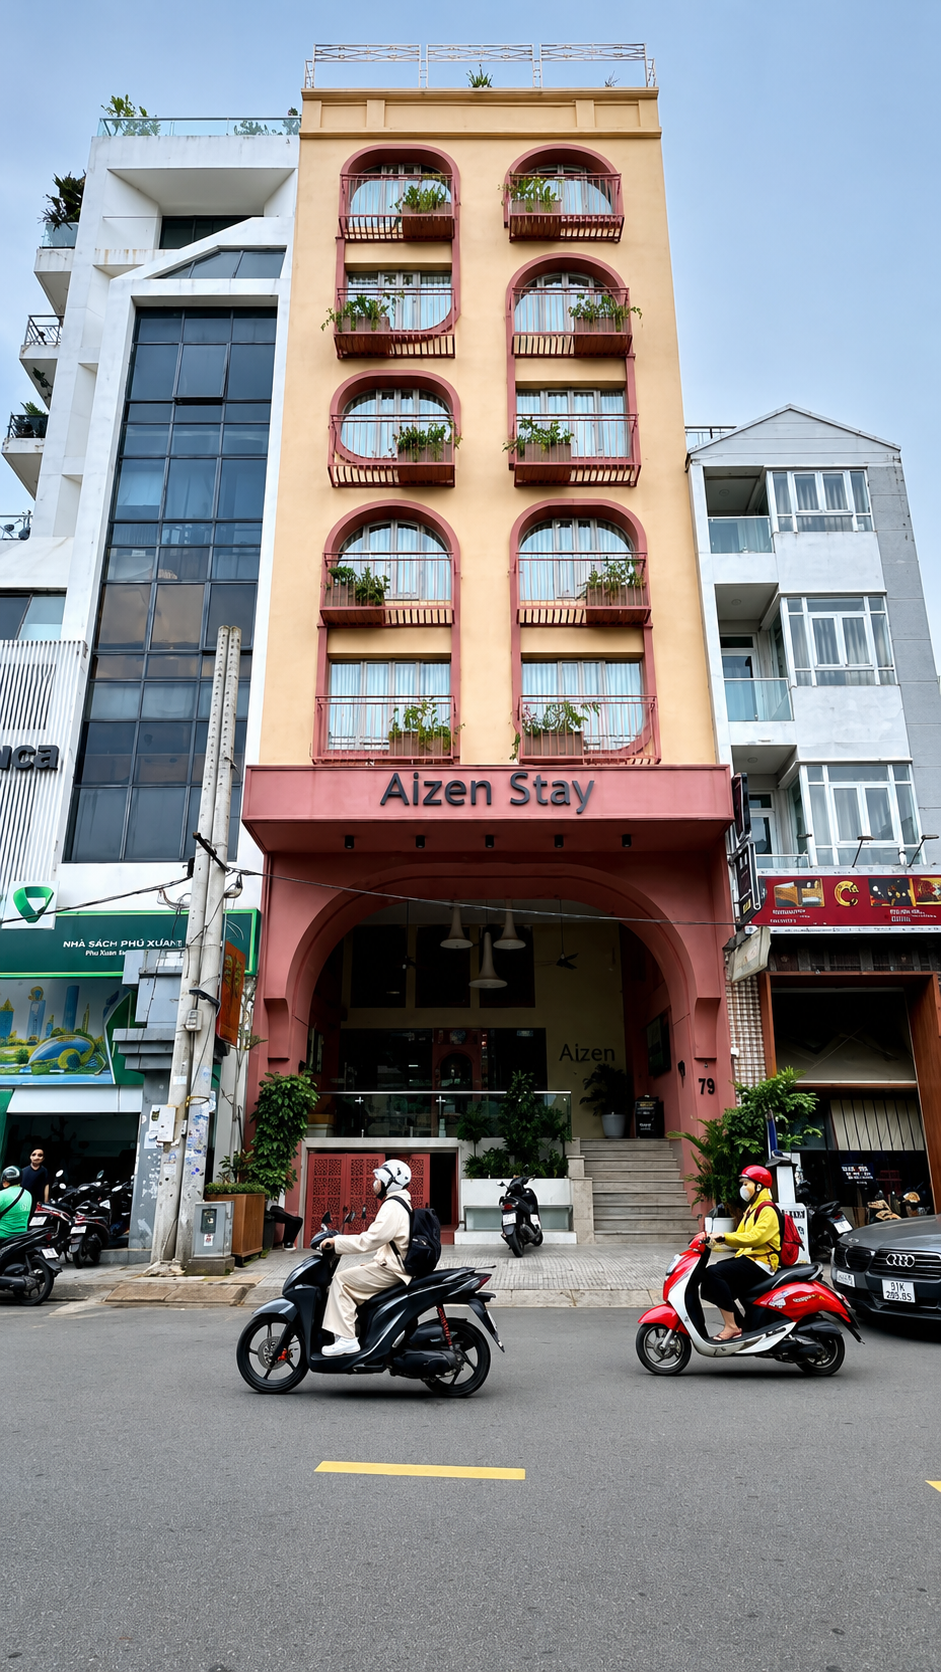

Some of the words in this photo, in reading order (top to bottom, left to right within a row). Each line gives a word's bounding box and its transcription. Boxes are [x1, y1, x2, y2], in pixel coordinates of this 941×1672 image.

[379, 771, 492, 806] Aizen
[509, 771, 595, 815] Stay
[558, 1043, 616, 1062] Aizen
[698, 1077, 715, 1095] 79
